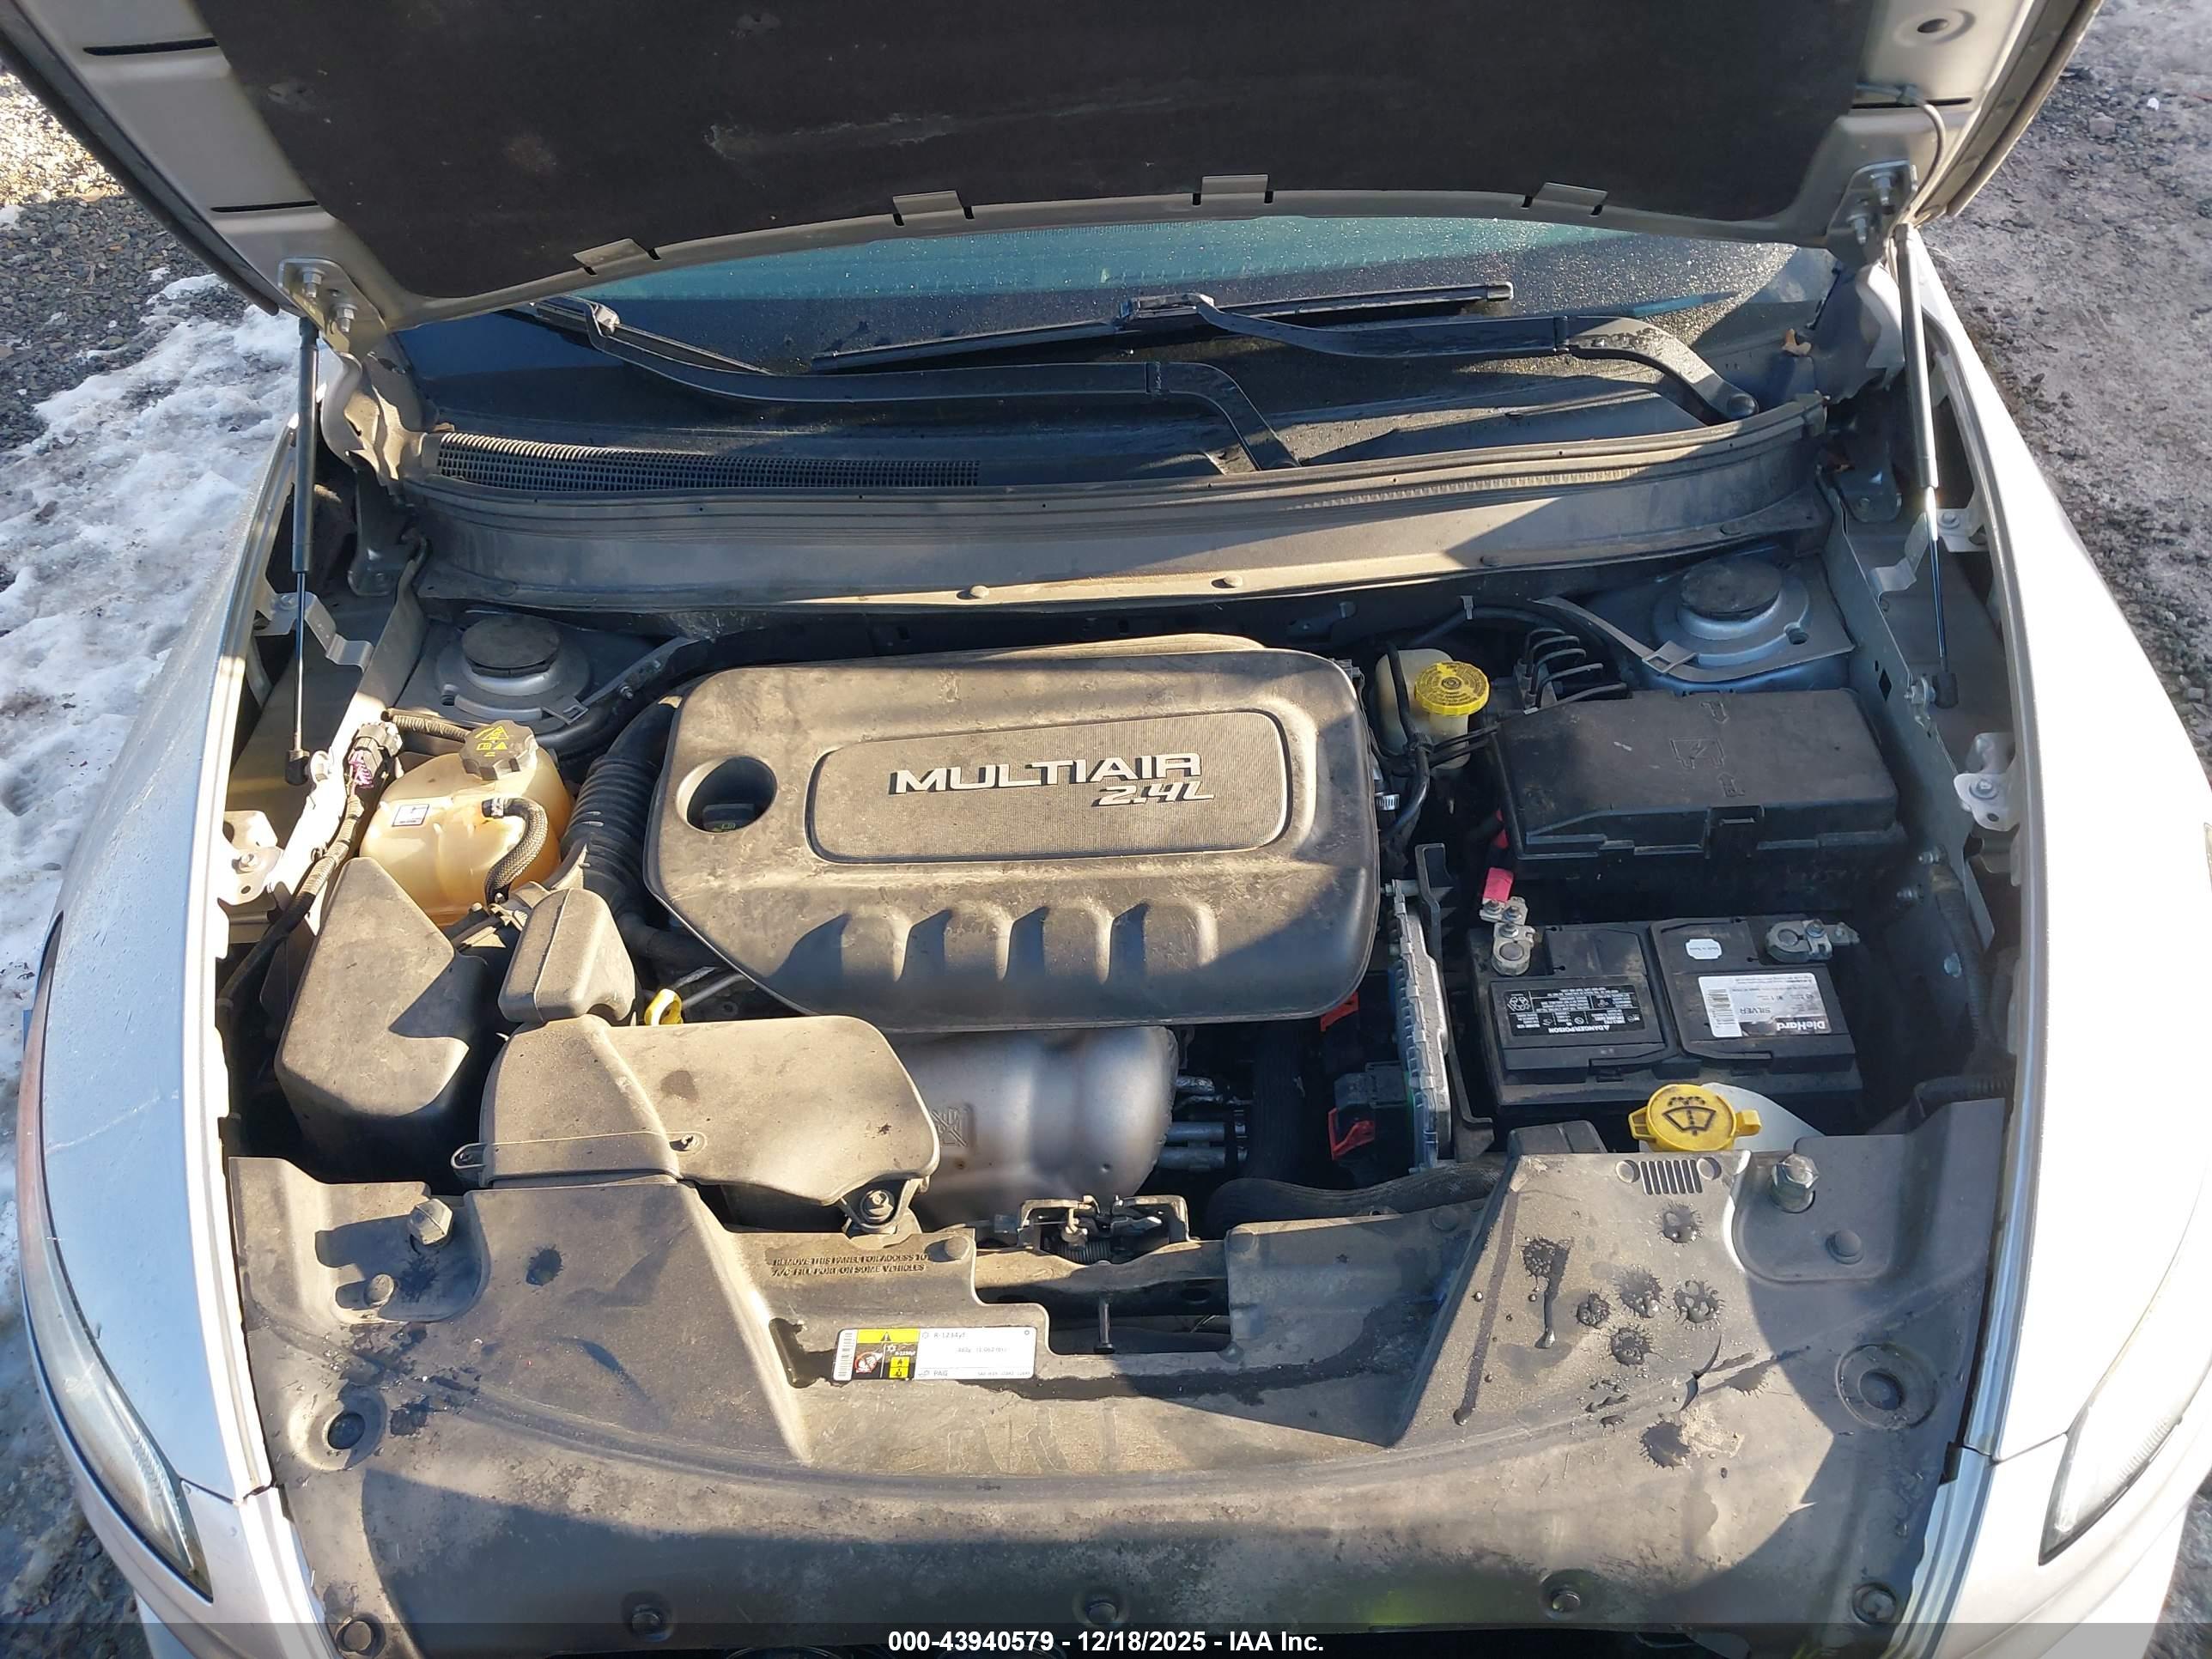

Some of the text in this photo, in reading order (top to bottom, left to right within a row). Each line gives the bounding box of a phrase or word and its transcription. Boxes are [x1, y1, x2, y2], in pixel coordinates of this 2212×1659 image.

[890, 753, 1202, 793] MULTIAIR
[1094, 781, 1214, 805] 2.4L
[1776, 1020, 1826, 1031] DieHard
